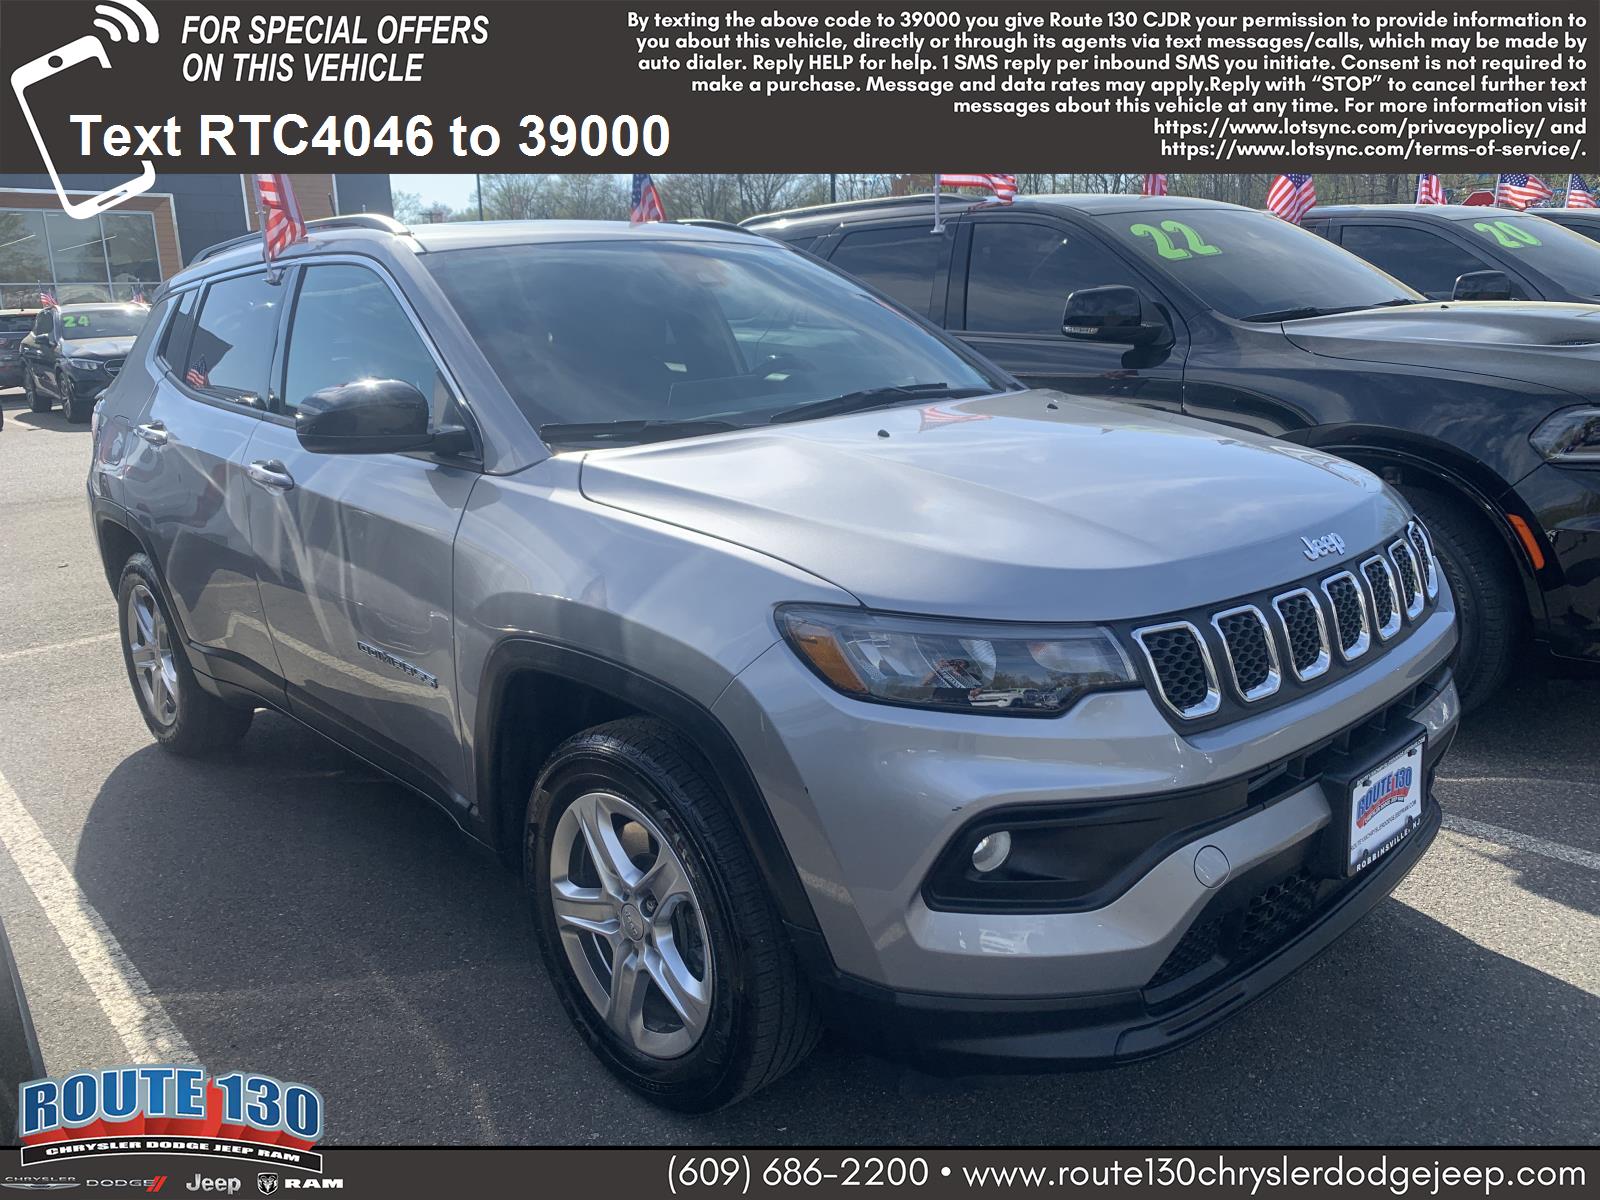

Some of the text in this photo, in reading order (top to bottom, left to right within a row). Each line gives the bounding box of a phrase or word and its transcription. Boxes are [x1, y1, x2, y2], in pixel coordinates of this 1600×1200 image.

[1130, 219, 1223, 260] 22
[1473, 221, 1543, 248] 20
[63, 315, 89, 328] 24
[1300, 532, 1345, 561] Jeep
[1357, 773, 1393, 819] ROUTE
[1394, 766, 1413, 788] 130
[1412, 818, 1421, 830] NJ
